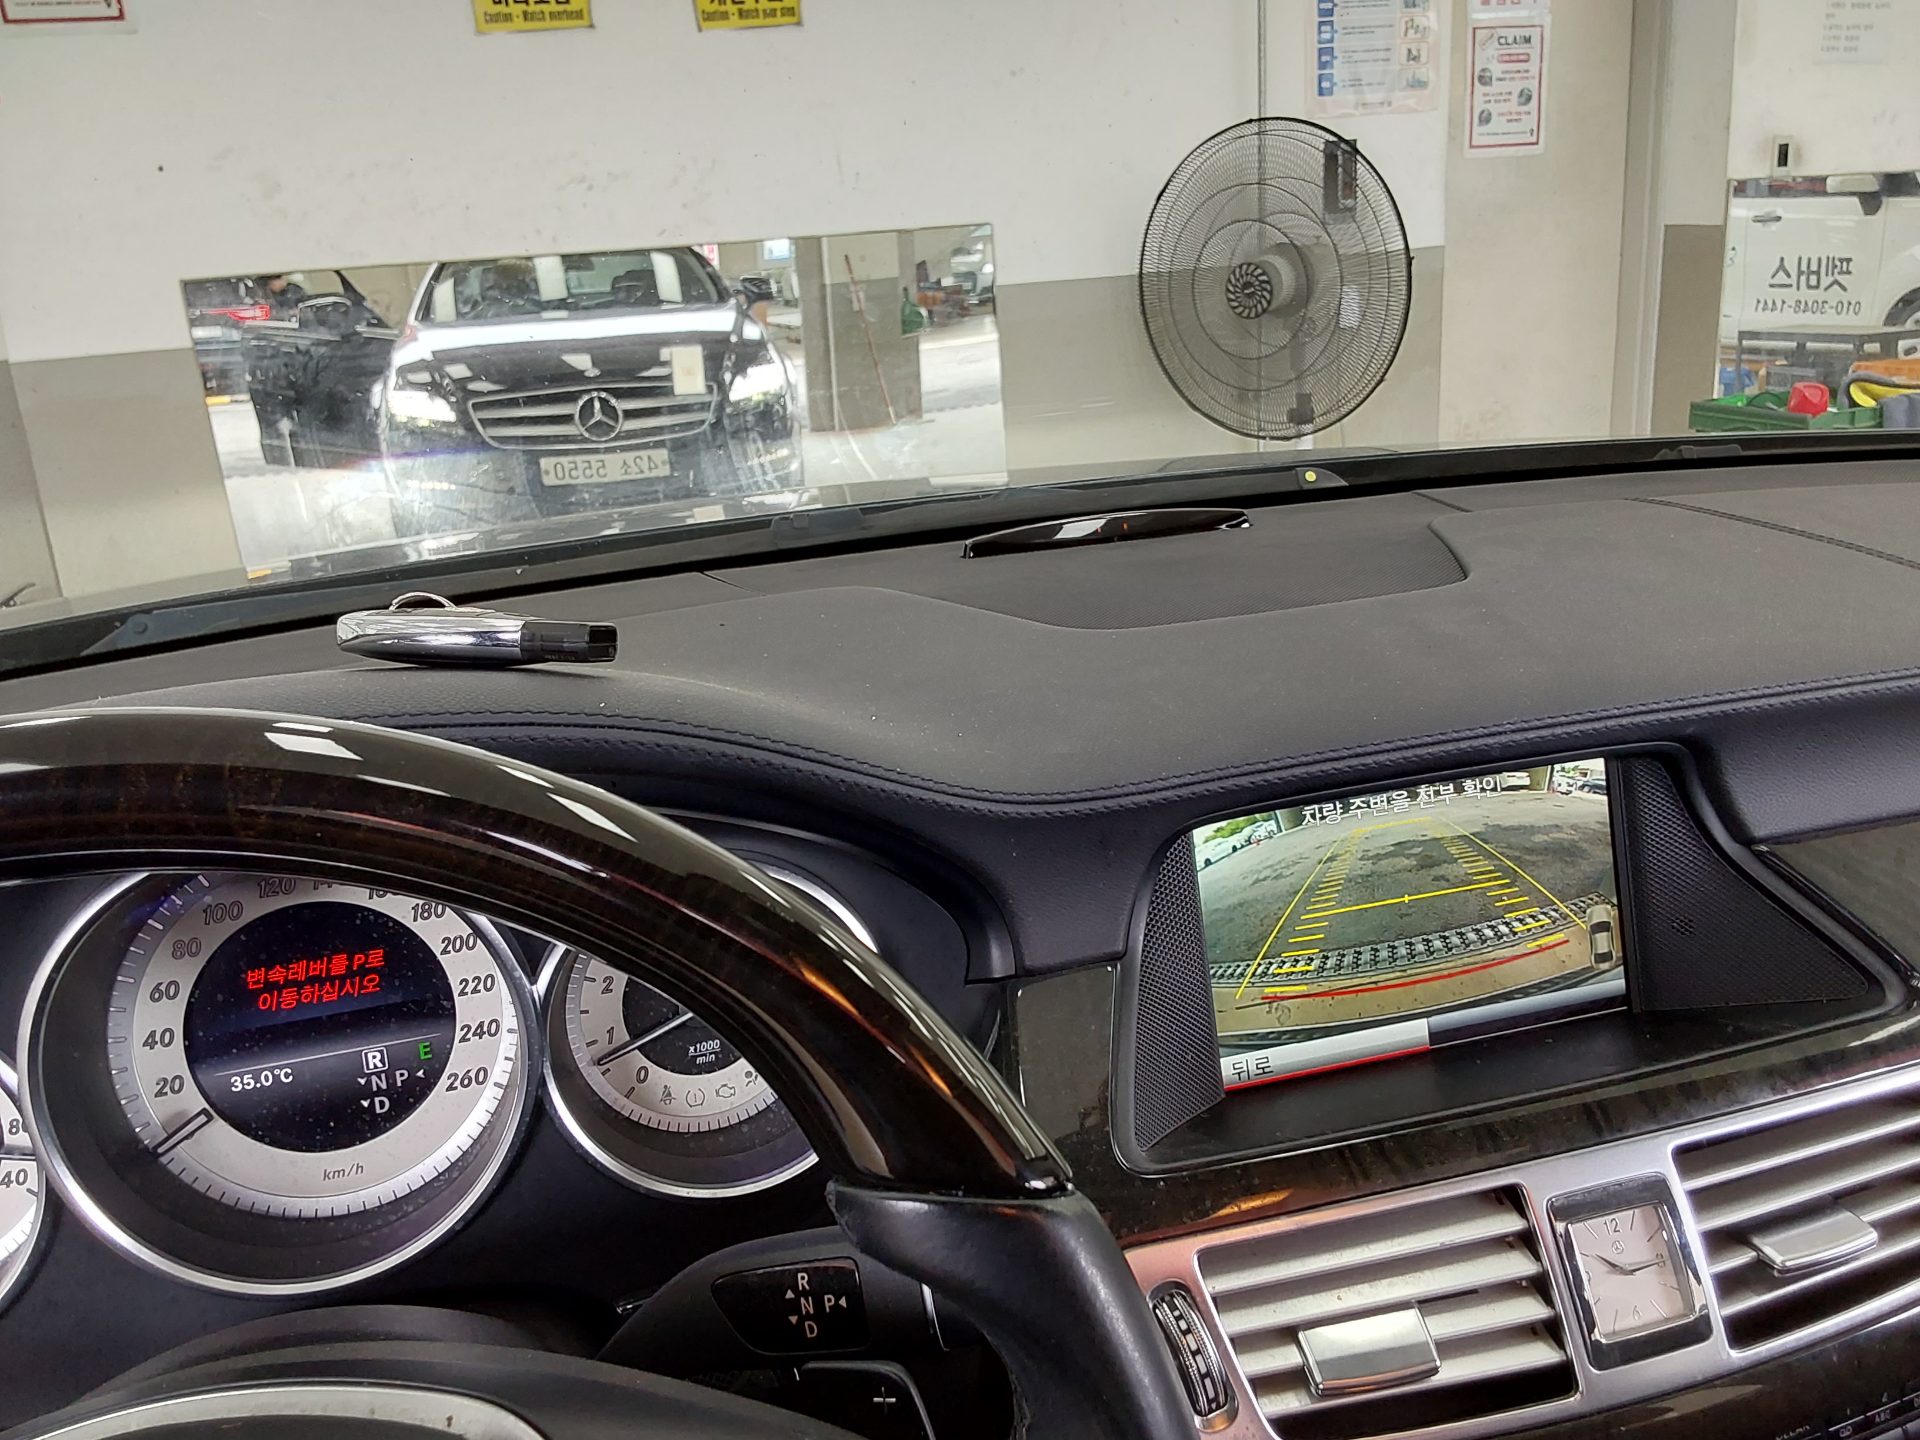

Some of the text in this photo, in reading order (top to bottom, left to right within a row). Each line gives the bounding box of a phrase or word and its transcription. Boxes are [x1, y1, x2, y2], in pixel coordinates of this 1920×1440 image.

[1496, 34, 1532, 47] CLAIM
[1301, 800, 1343, 827] 차량
[1349, 790, 1411, 820] 주변을
[1462, 774, 1502, 801] 확인
[257, 877, 297, 899] 120
[202, 900, 244, 926] 100
[411, 901, 447, 923] 180
[171, 937, 202, 960] 80
[440, 932, 478, 956] 200
[246, 948, 385, 990] 변속레버를 P로
[149, 980, 181, 1003] 60
[258, 973, 381, 1012] 이동하십시오
[457, 973, 496, 997] 220
[601, 975, 615, 994] 2
[142, 1027, 175, 1050] 40
[458, 1018, 500, 1043] 240
[606, 1026, 615, 1045] 1
[419, 1041, 433, 1060] E
[688, 1039, 721, 1054] x1000
[366, 1051, 384, 1070] R
[696, 1053, 716, 1065] min
[1231, 1055, 1275, 1081] 뒤로
[371, 1069, 409, 1092] N P
[445, 1066, 489, 1092] 260
[635, 1065, 649, 1084] 0
[154, 1074, 185, 1098] 20
[374, 1095, 391, 1114] D
[0, 1168, 28, 1188] 40
[322, 1161, 365, 1182] km/h
[1603, 1217, 1621, 1236] 12
[797, 1272, 810, 1291] R
[800, 1294, 835, 1315] N P
[1632, 1304, 1643, 1321] 6
[804, 1321, 818, 1338] D
